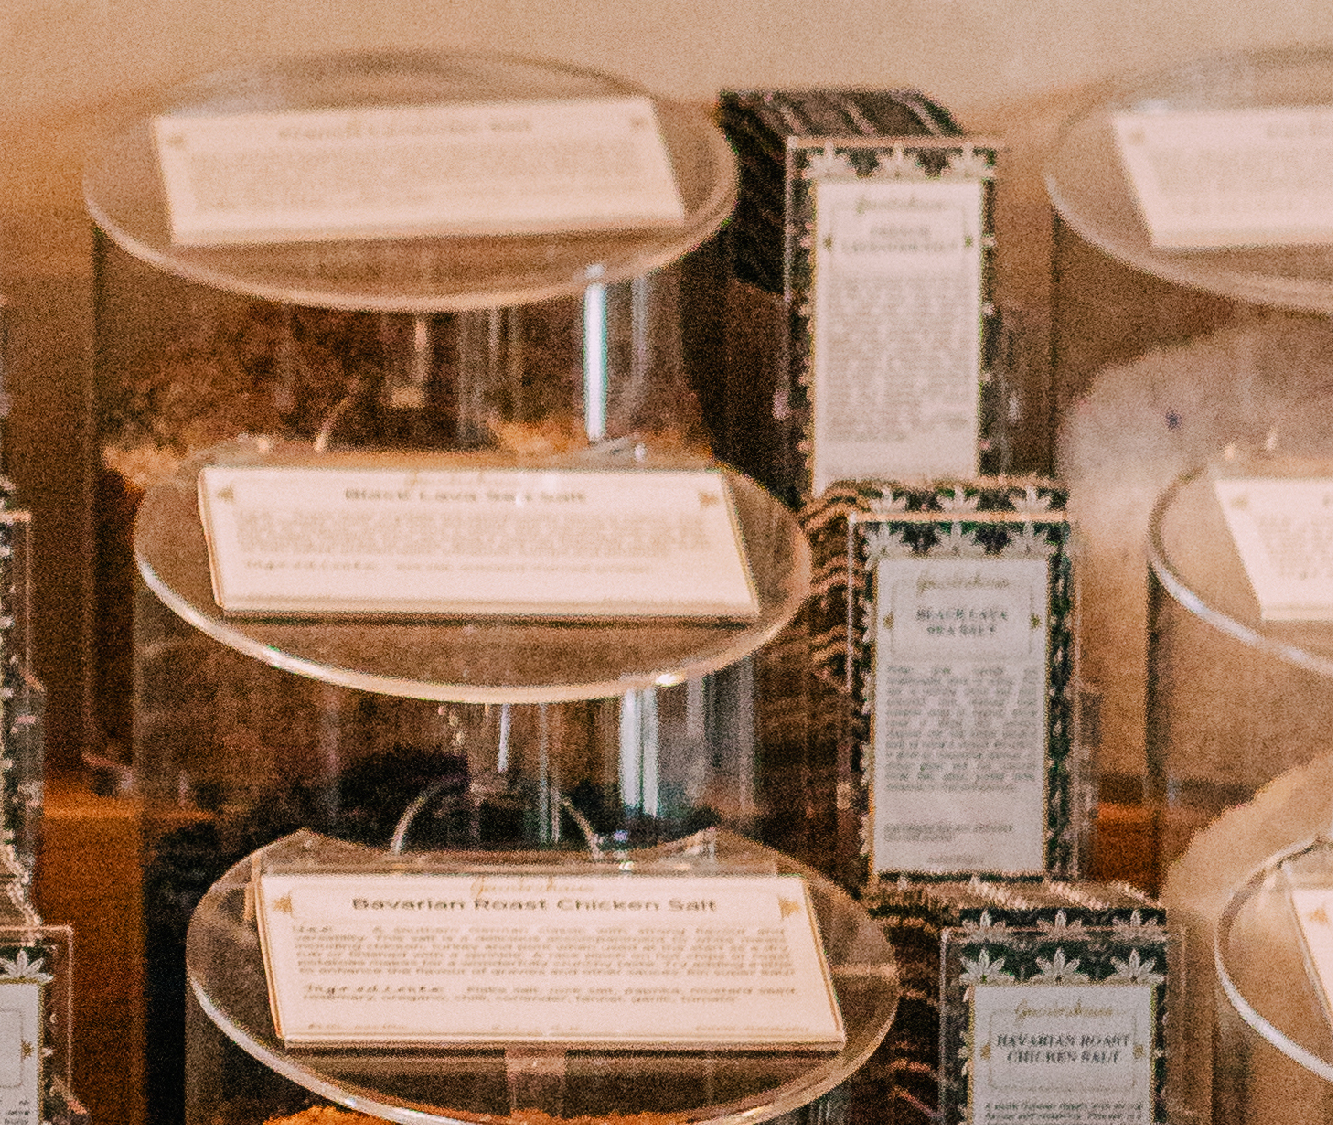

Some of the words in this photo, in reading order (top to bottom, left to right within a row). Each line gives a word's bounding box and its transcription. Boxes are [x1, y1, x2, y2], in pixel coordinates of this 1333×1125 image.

[352, 898, 465, 911] Bavarian
[474, 899, 546, 911] Roast
[556, 899, 659, 911] Chicken
[668, 899, 717, 912] Salt
[996, 1032, 1076, 1047] BAVARIAN
[1081, 1032, 1132, 1047] ROAST
[1006, 1049, 1079, 1065] CHICKEN
[1082, 1048, 1120, 1064] SALT
